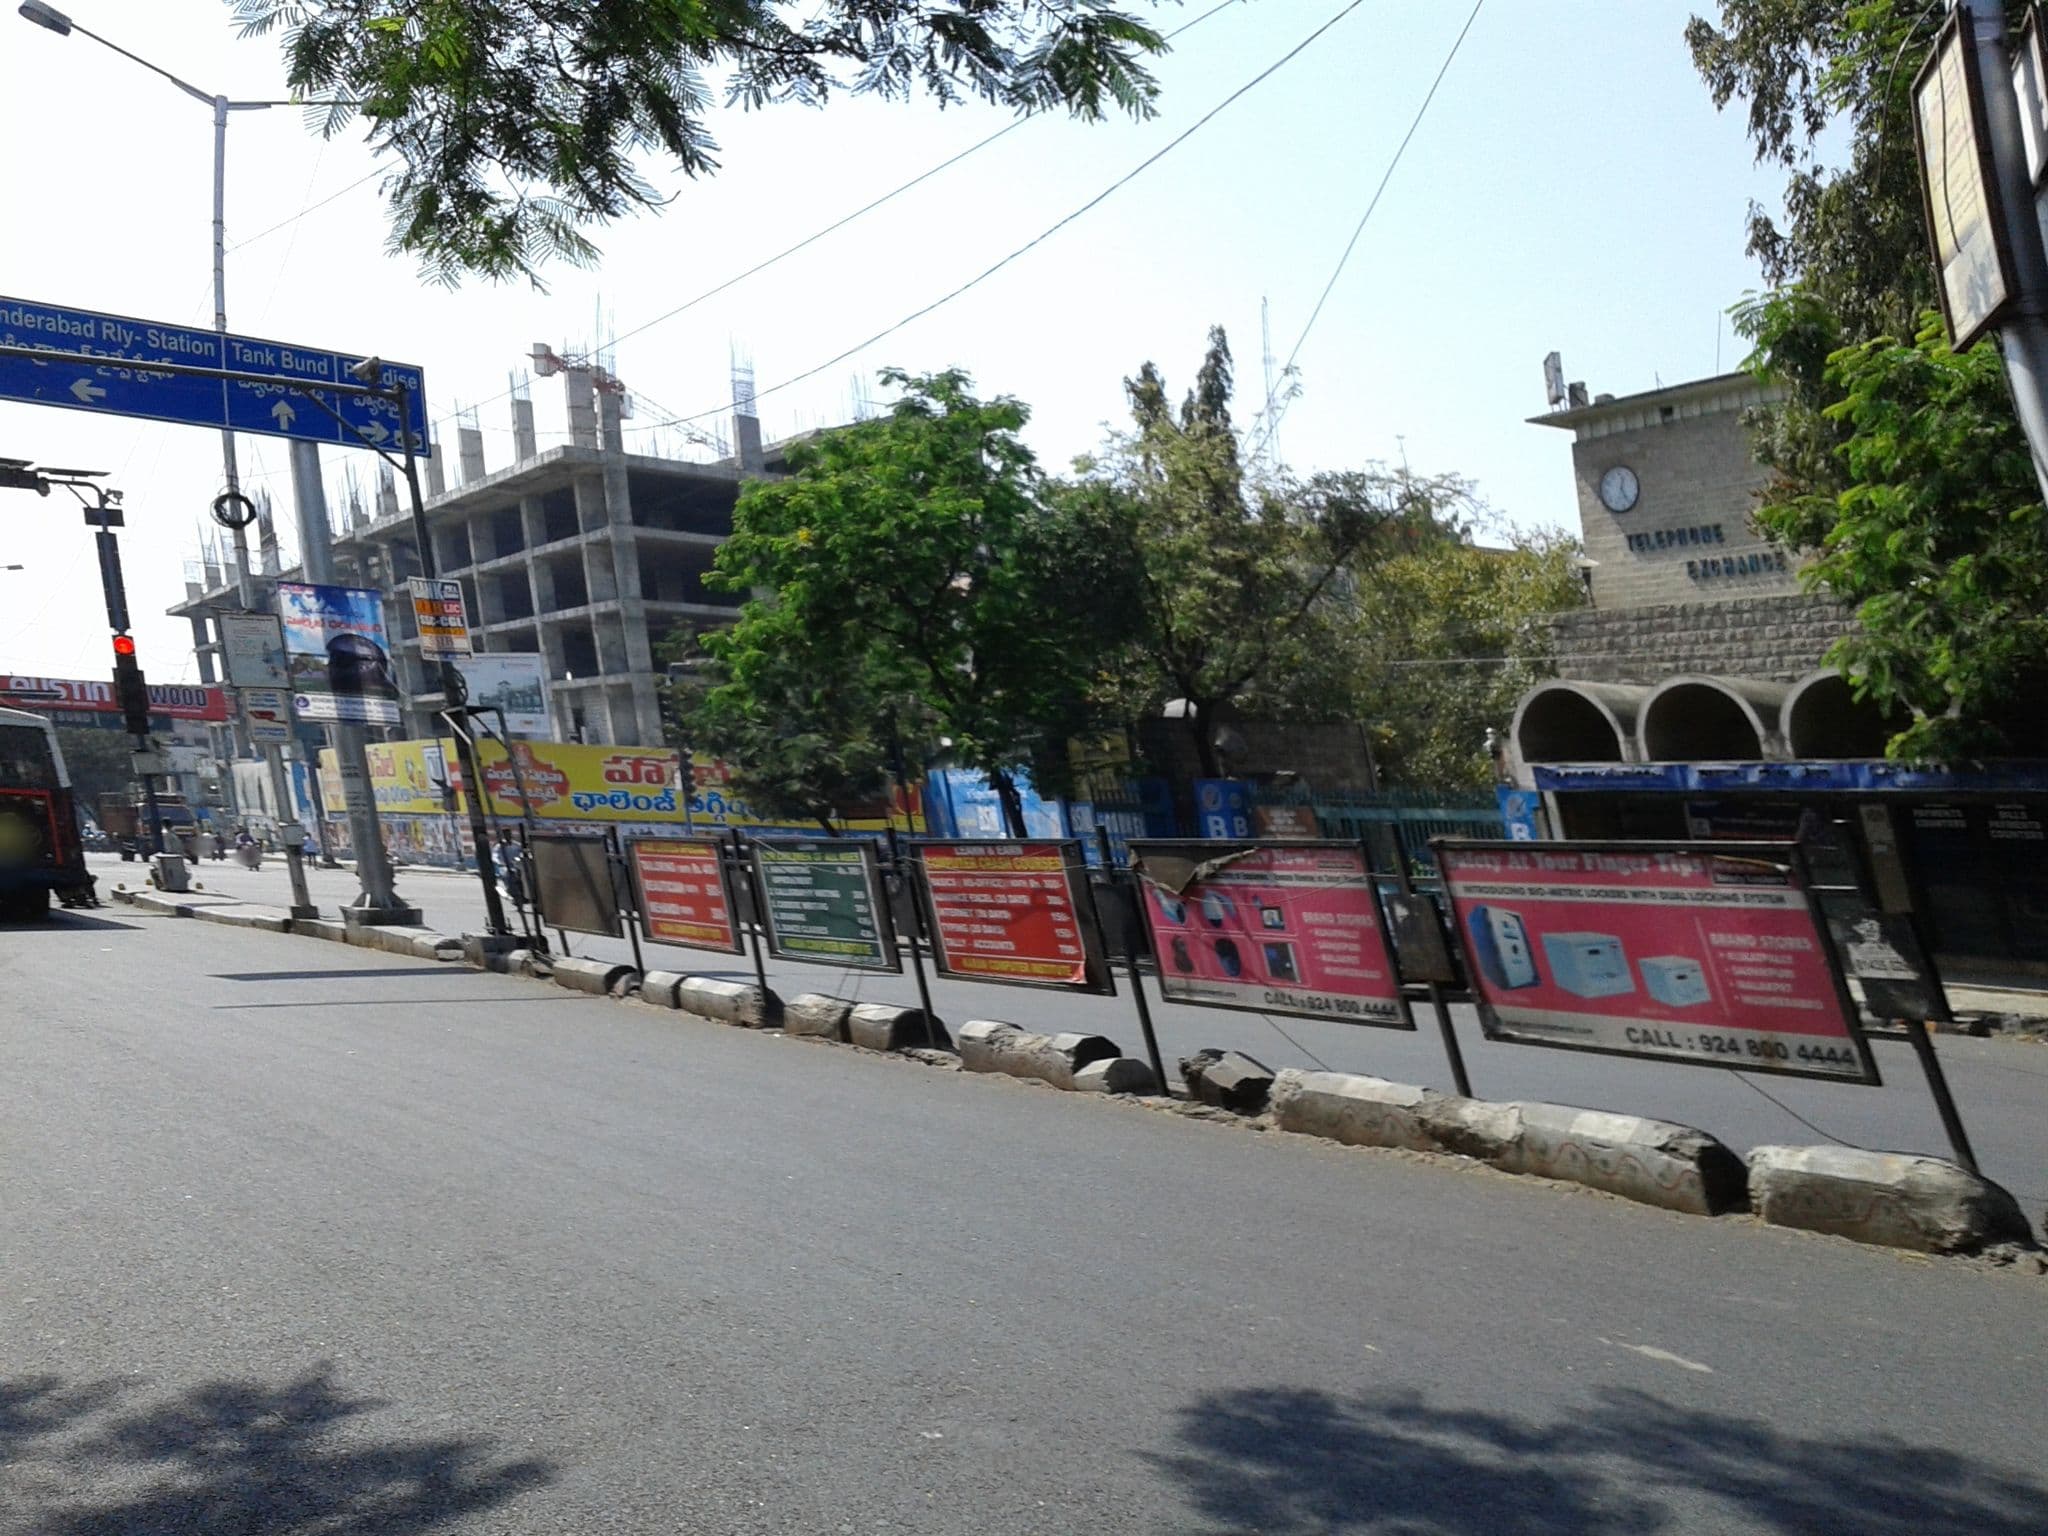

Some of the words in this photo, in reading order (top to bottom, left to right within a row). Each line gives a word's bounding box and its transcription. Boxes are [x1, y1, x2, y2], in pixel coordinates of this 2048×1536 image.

[147, 330, 215, 357] Station
[232, 342, 275, 368] Tank
[281, 351, 328, 375] Bund
[1627, 523, 1725, 552] TELEPHONE
[1687, 550, 1787, 580] EXCHANGE
[1534, 853, 1579, 871] Your
[1582, 853, 1649, 876] Finger
[1625, 1027, 1683, 1049] CALL
[1699, 1034, 1741, 1055] 924
[1748, 1039, 1790, 1060] 800
[1797, 1044, 1857, 1066] 4444
